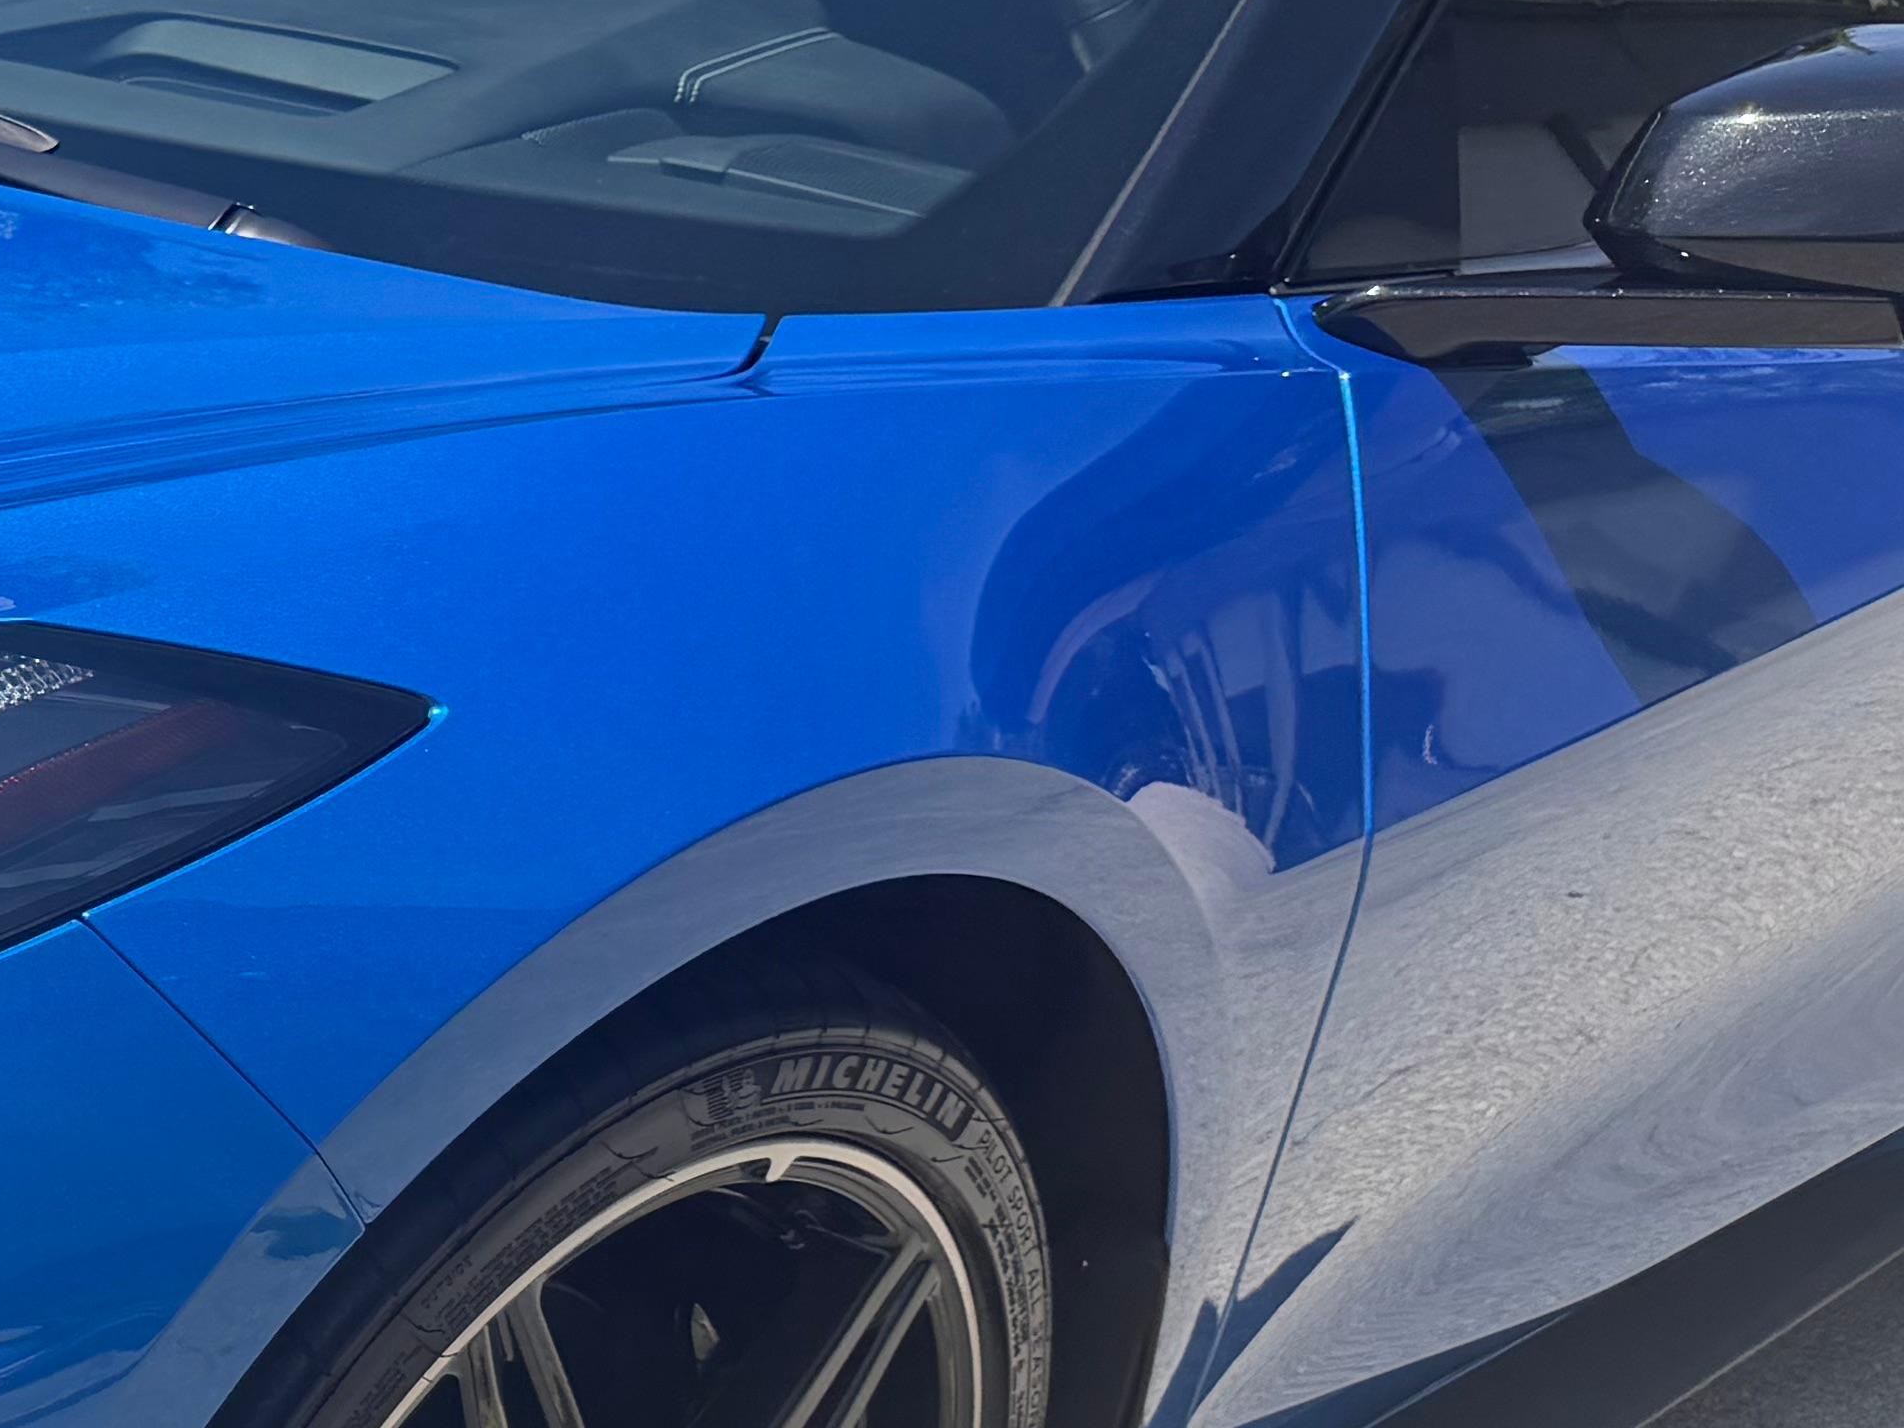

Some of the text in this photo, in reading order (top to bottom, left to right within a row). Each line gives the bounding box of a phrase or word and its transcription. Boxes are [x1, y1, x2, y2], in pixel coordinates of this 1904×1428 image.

[771, 1054, 966, 1130] MICHELIN
[978, 1129, 1012, 1183] PILOT
[1008, 1185, 1039, 1257] SPORT
[1028, 1269, 1041, 1313] ALL
